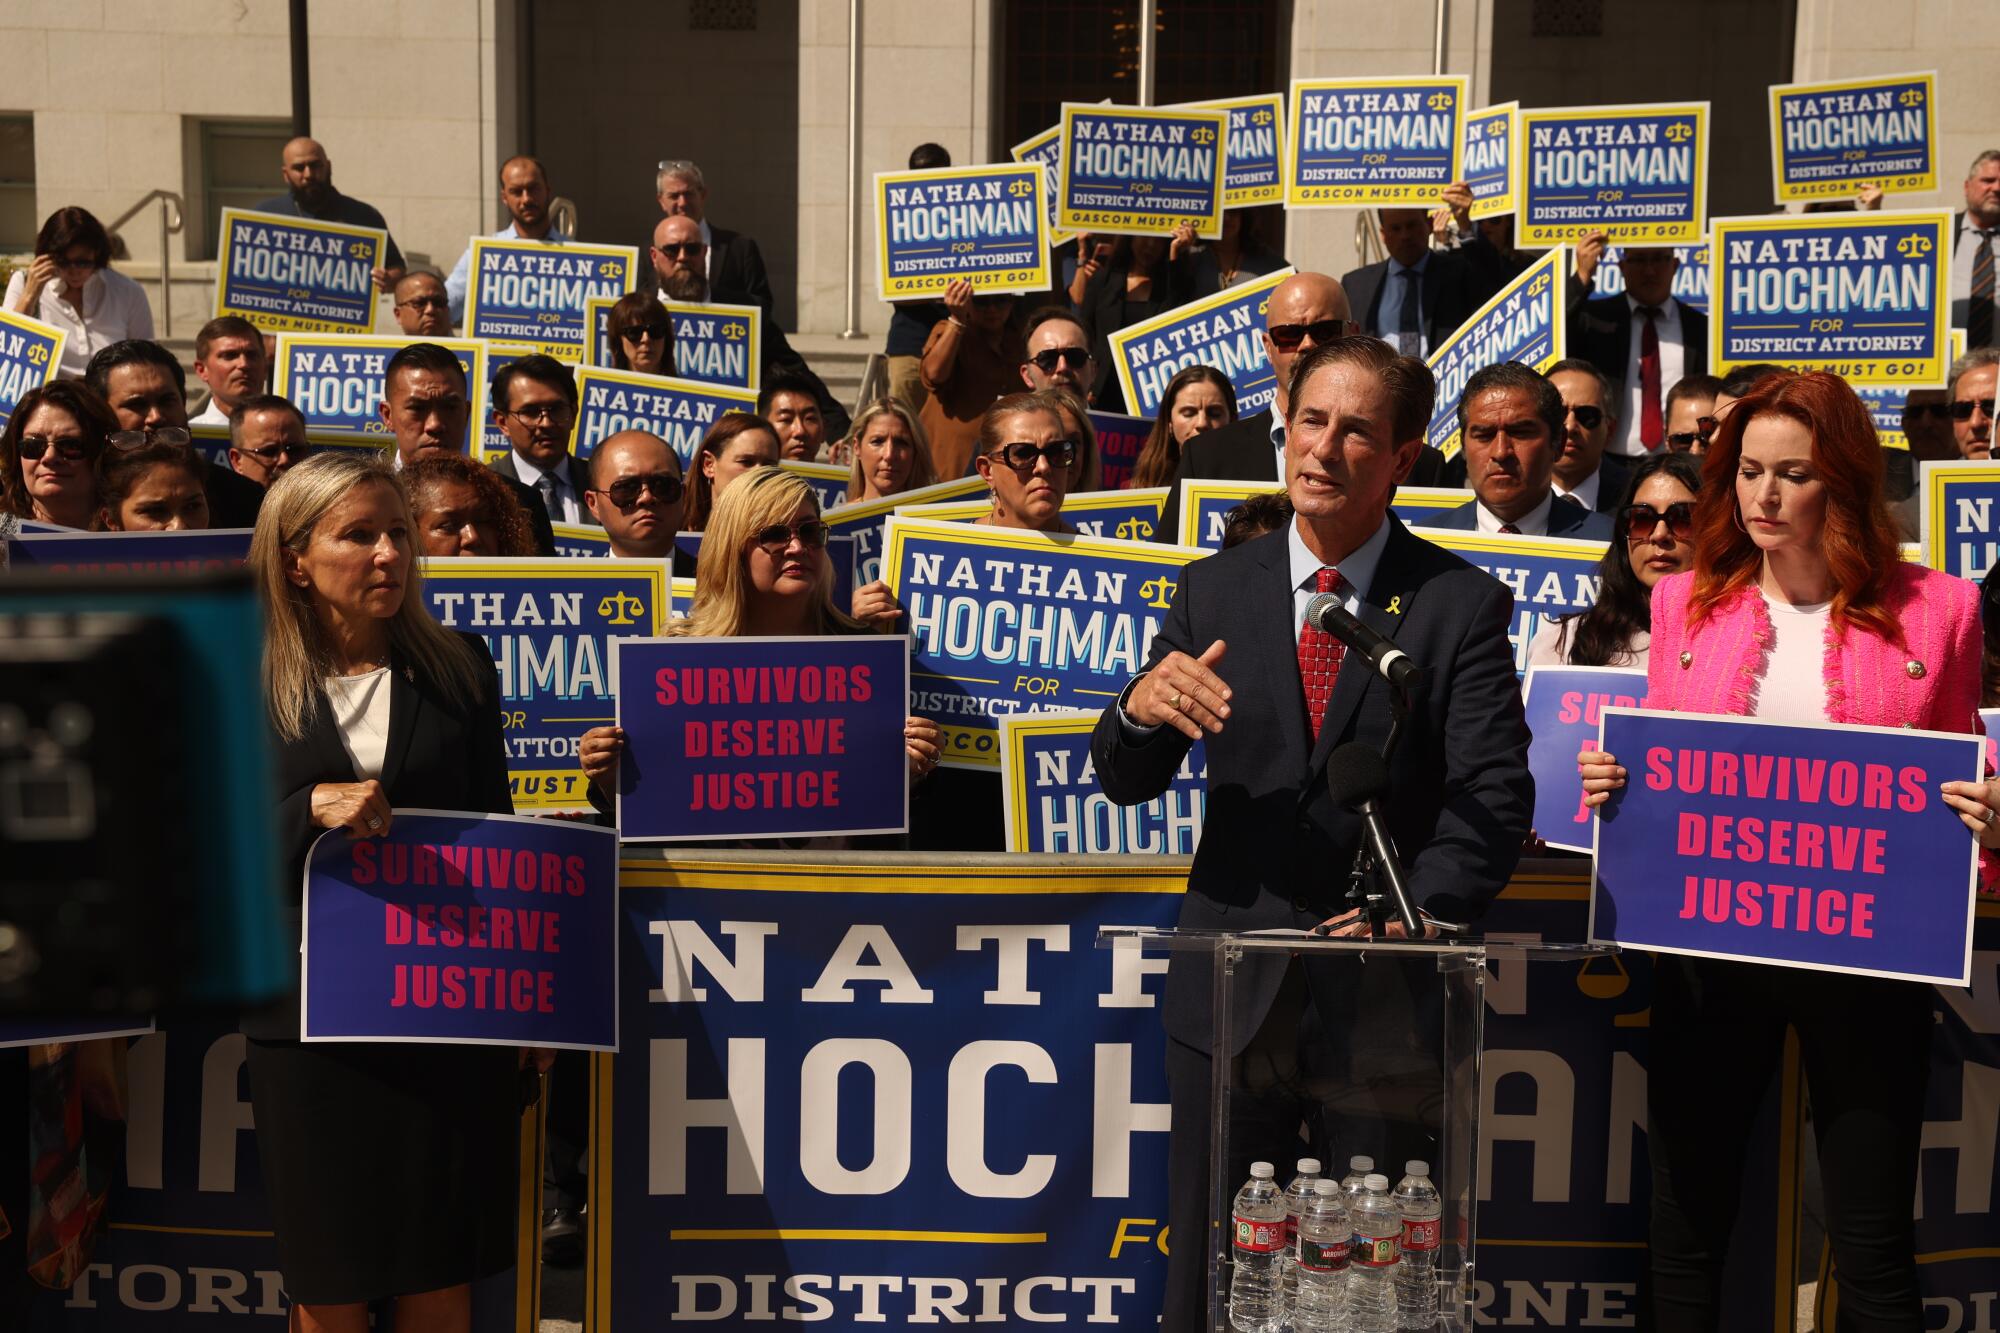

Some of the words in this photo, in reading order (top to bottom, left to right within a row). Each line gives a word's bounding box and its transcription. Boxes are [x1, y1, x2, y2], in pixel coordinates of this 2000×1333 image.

[1304, 93, 1421, 114] NATHAN
[1784, 91, 1893, 118] NATHAN
[1075, 121, 1186, 144] NATHAN
[1304, 114, 1451, 151] HOCHMAN
[1533, 124, 1658, 148] NATHAN
[1786, 109, 1924, 151] HOCHMAN
[1074, 142, 1212, 182] HOCHMAN
[1362, 154, 1387, 164] FOR
[1534, 146, 1692, 189] HOCHMAN
[1843, 151, 1867, 161] FOR
[1303, 168, 1367, 181] DISTRICT
[1368, 167, 1446, 180] ATTORNEY
[1789, 164, 1849, 179] DISTRICT
[1850, 158, 1923, 174] ATTORNEY
[889, 181, 1002, 206] NATHAN
[1129, 183, 1153, 194] FOR
[1225, 191, 1247, 200] UST
[1301, 188, 1363, 198] GASCON
[1370, 188, 1411, 197] MUST
[1596, 191, 1624, 202] FOR
[1790, 183, 1848, 195] GASCON
[1897, 177, 1924, 187] GO!
[1073, 193, 1134, 207] DISTRICT
[1136, 196, 1208, 211] ATTORNEY
[1534, 206, 1602, 220] DISTRICT
[1603, 203, 1687, 218] ATTORNEY
[892, 200, 1034, 243] HOCHMAN
[1072, 213, 1132, 225] GASCON
[1137, 215, 1175, 226] MUST
[1533, 227, 1599, 238] GASCO
[1607, 226, 1649, 237] MUST
[1656, 225, 1687, 236] GO!
[234, 225, 344, 256] NATHAN
[951, 242, 976, 253] FOR
[1730, 235, 1888, 264] NATHAN
[233, 245, 369, 294] HOCHMAN
[483, 253, 594, 277] NATHAN
[894, 257, 956, 272] DISTRICT
[958, 252, 1033, 267] ATTORNEY
[1007, 271, 1034, 281] GO!
[287, 288, 311, 299] FOR
[1731, 263, 1930, 315] HOCHMAN
[231, 292, 291, 311] DISTRICT
[292, 302, 364, 321] ATTORNEY
[537, 313, 561, 323] FOR
[293, 319, 330, 332] MUST
[480, 322, 541, 336] DISTRICT
[1129, 305, 1251, 368] NATHAN
[1432, 291, 1522, 380] NATHAN
[1809, 319, 1844, 332] FOR
[1731, 338, 1817, 353] DISTRICT
[1818, 336, 1925, 352] ATTORNEY
[294, 352, 385, 375] NATH
[1886, 363, 1925, 375] GO!
[294, 376, 386, 416] HOCH
[587, 387, 717, 423] NATHAN
[910, 552, 1128, 605] NATHAN
[434, 592, 583, 626] THAN
[655, 664, 873, 706] SURVIVORS
[1013, 675, 1060, 696] FOR
[684, 718, 846, 757] DESERVE
[690, 770, 840, 811] JUSTICE
[1645, 746, 1928, 813] SURVIVORS
[1677, 812, 1887, 874] DESERVE
[351, 840, 585, 897] SURVIVORS
[1679, 876, 1875, 939] JUSTICE
[385, 903, 560, 953] DESERVE
[390, 964, 554, 1013] JUSTICE
[670, 1273, 1135, 1324] DISTRICT
